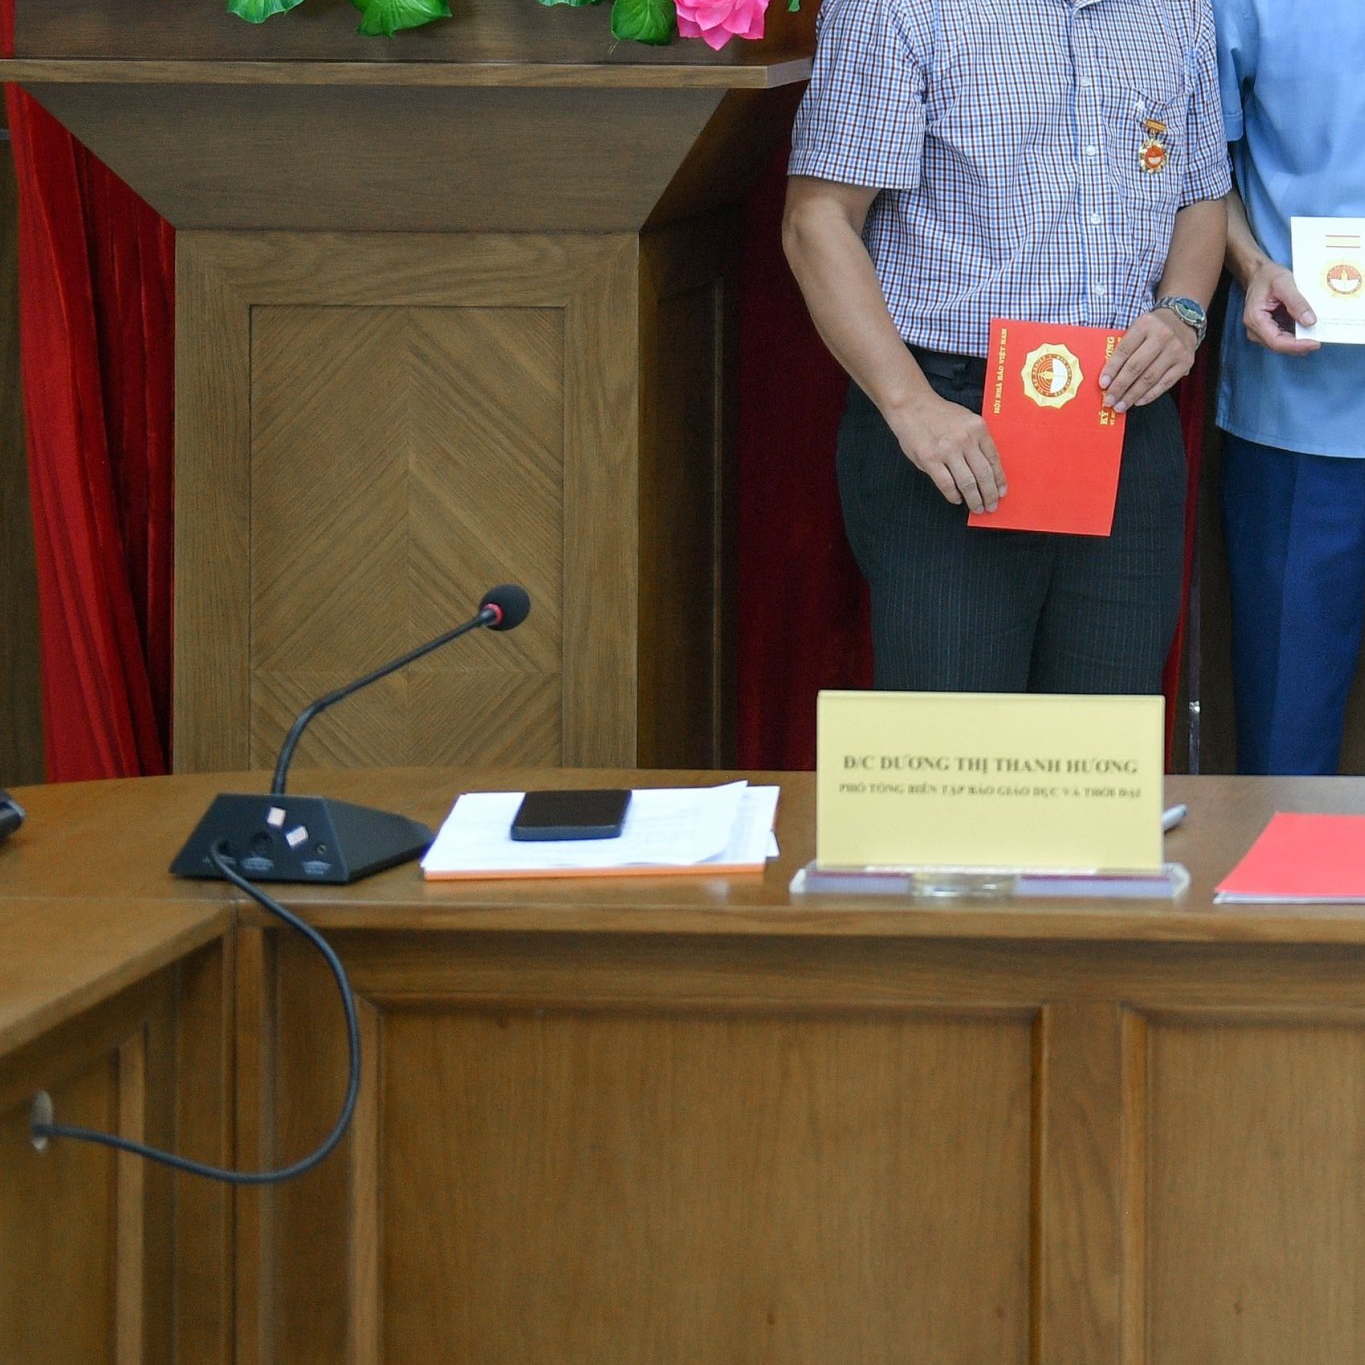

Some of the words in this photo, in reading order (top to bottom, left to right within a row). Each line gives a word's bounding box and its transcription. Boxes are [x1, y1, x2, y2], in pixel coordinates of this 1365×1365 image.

[1000, 328, 1008, 345] NAM
[843, 754, 875, 771] Đ/C
[995, 757, 1062, 774] THANH
[1066, 757, 1139, 776] HƯƠNG
